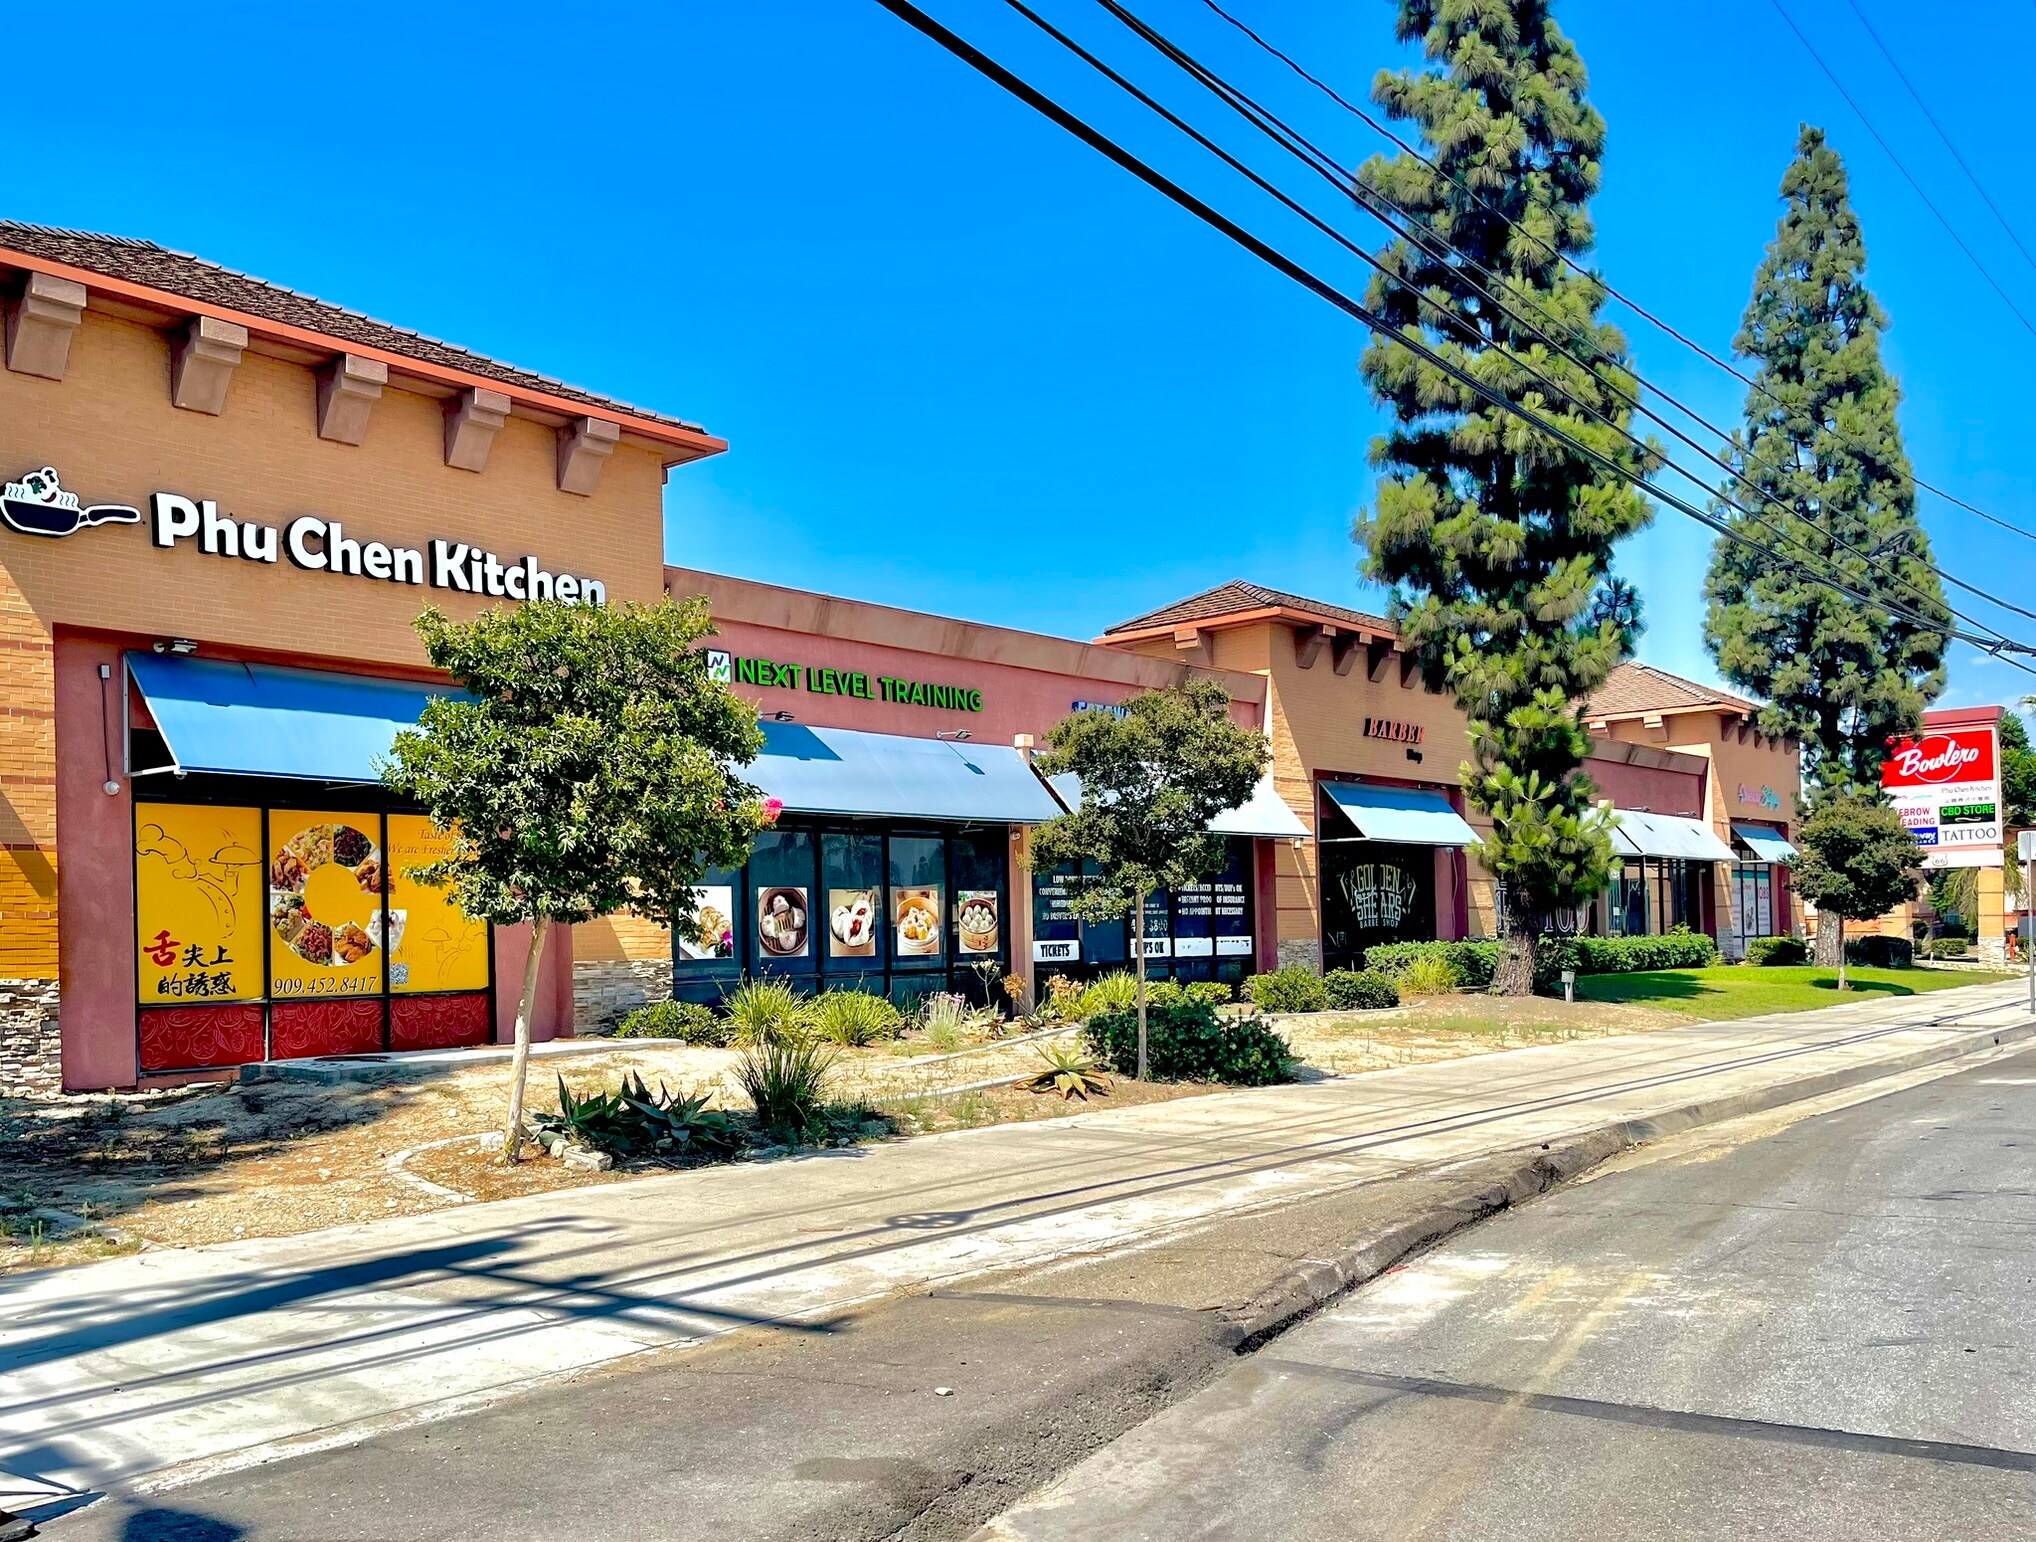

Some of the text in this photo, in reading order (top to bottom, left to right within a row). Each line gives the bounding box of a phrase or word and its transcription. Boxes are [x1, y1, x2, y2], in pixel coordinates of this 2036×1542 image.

[154, 492, 606, 606] Phu Chen Kitchen
[736, 657, 983, 712] NEXT LEVEL TRAINING
[1365, 718, 1425, 744] BARBER
[1893, 740, 1979, 777] Bowlero
[1898, 807, 1930, 817] EBROW
[1941, 804, 1995, 816] CBD STORE
[1901, 817, 1935, 827] EADING
[1942, 827, 1997, 841] TATTOO
[388, 843, 403, 854] We
[1356, 864, 1401, 894] GOLDEN
[1200, 895, 1213, 904] PROO
[1355, 891, 1402, 922] SHEARS
[143, 929, 234, 968] 舌尖上
[1040, 944, 1070, 957] TICKETS
[274, 976, 378, 995] 909.452.8417
